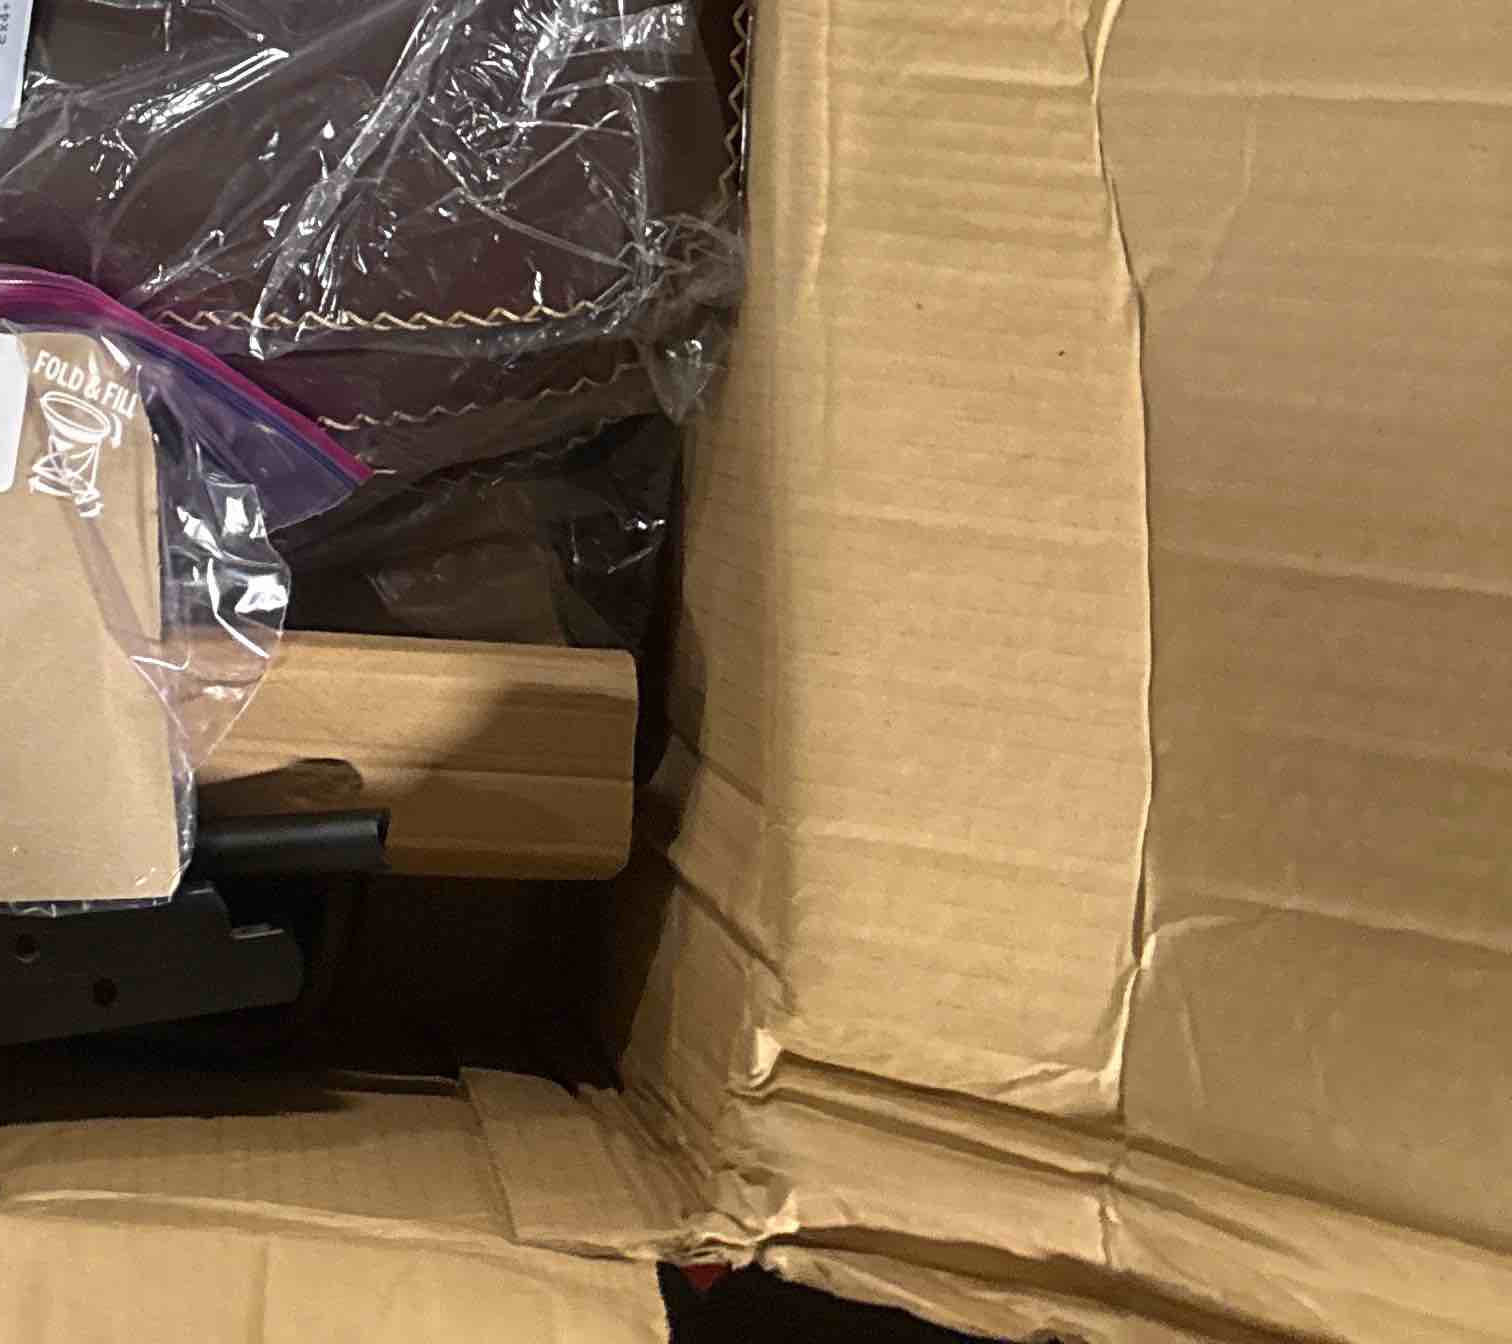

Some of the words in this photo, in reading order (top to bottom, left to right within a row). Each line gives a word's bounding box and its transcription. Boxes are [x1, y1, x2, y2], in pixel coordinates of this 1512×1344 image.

[33, 349, 86, 391] FOLD
[85, 369, 104, 401] &
[100, 380, 141, 421] FILL
